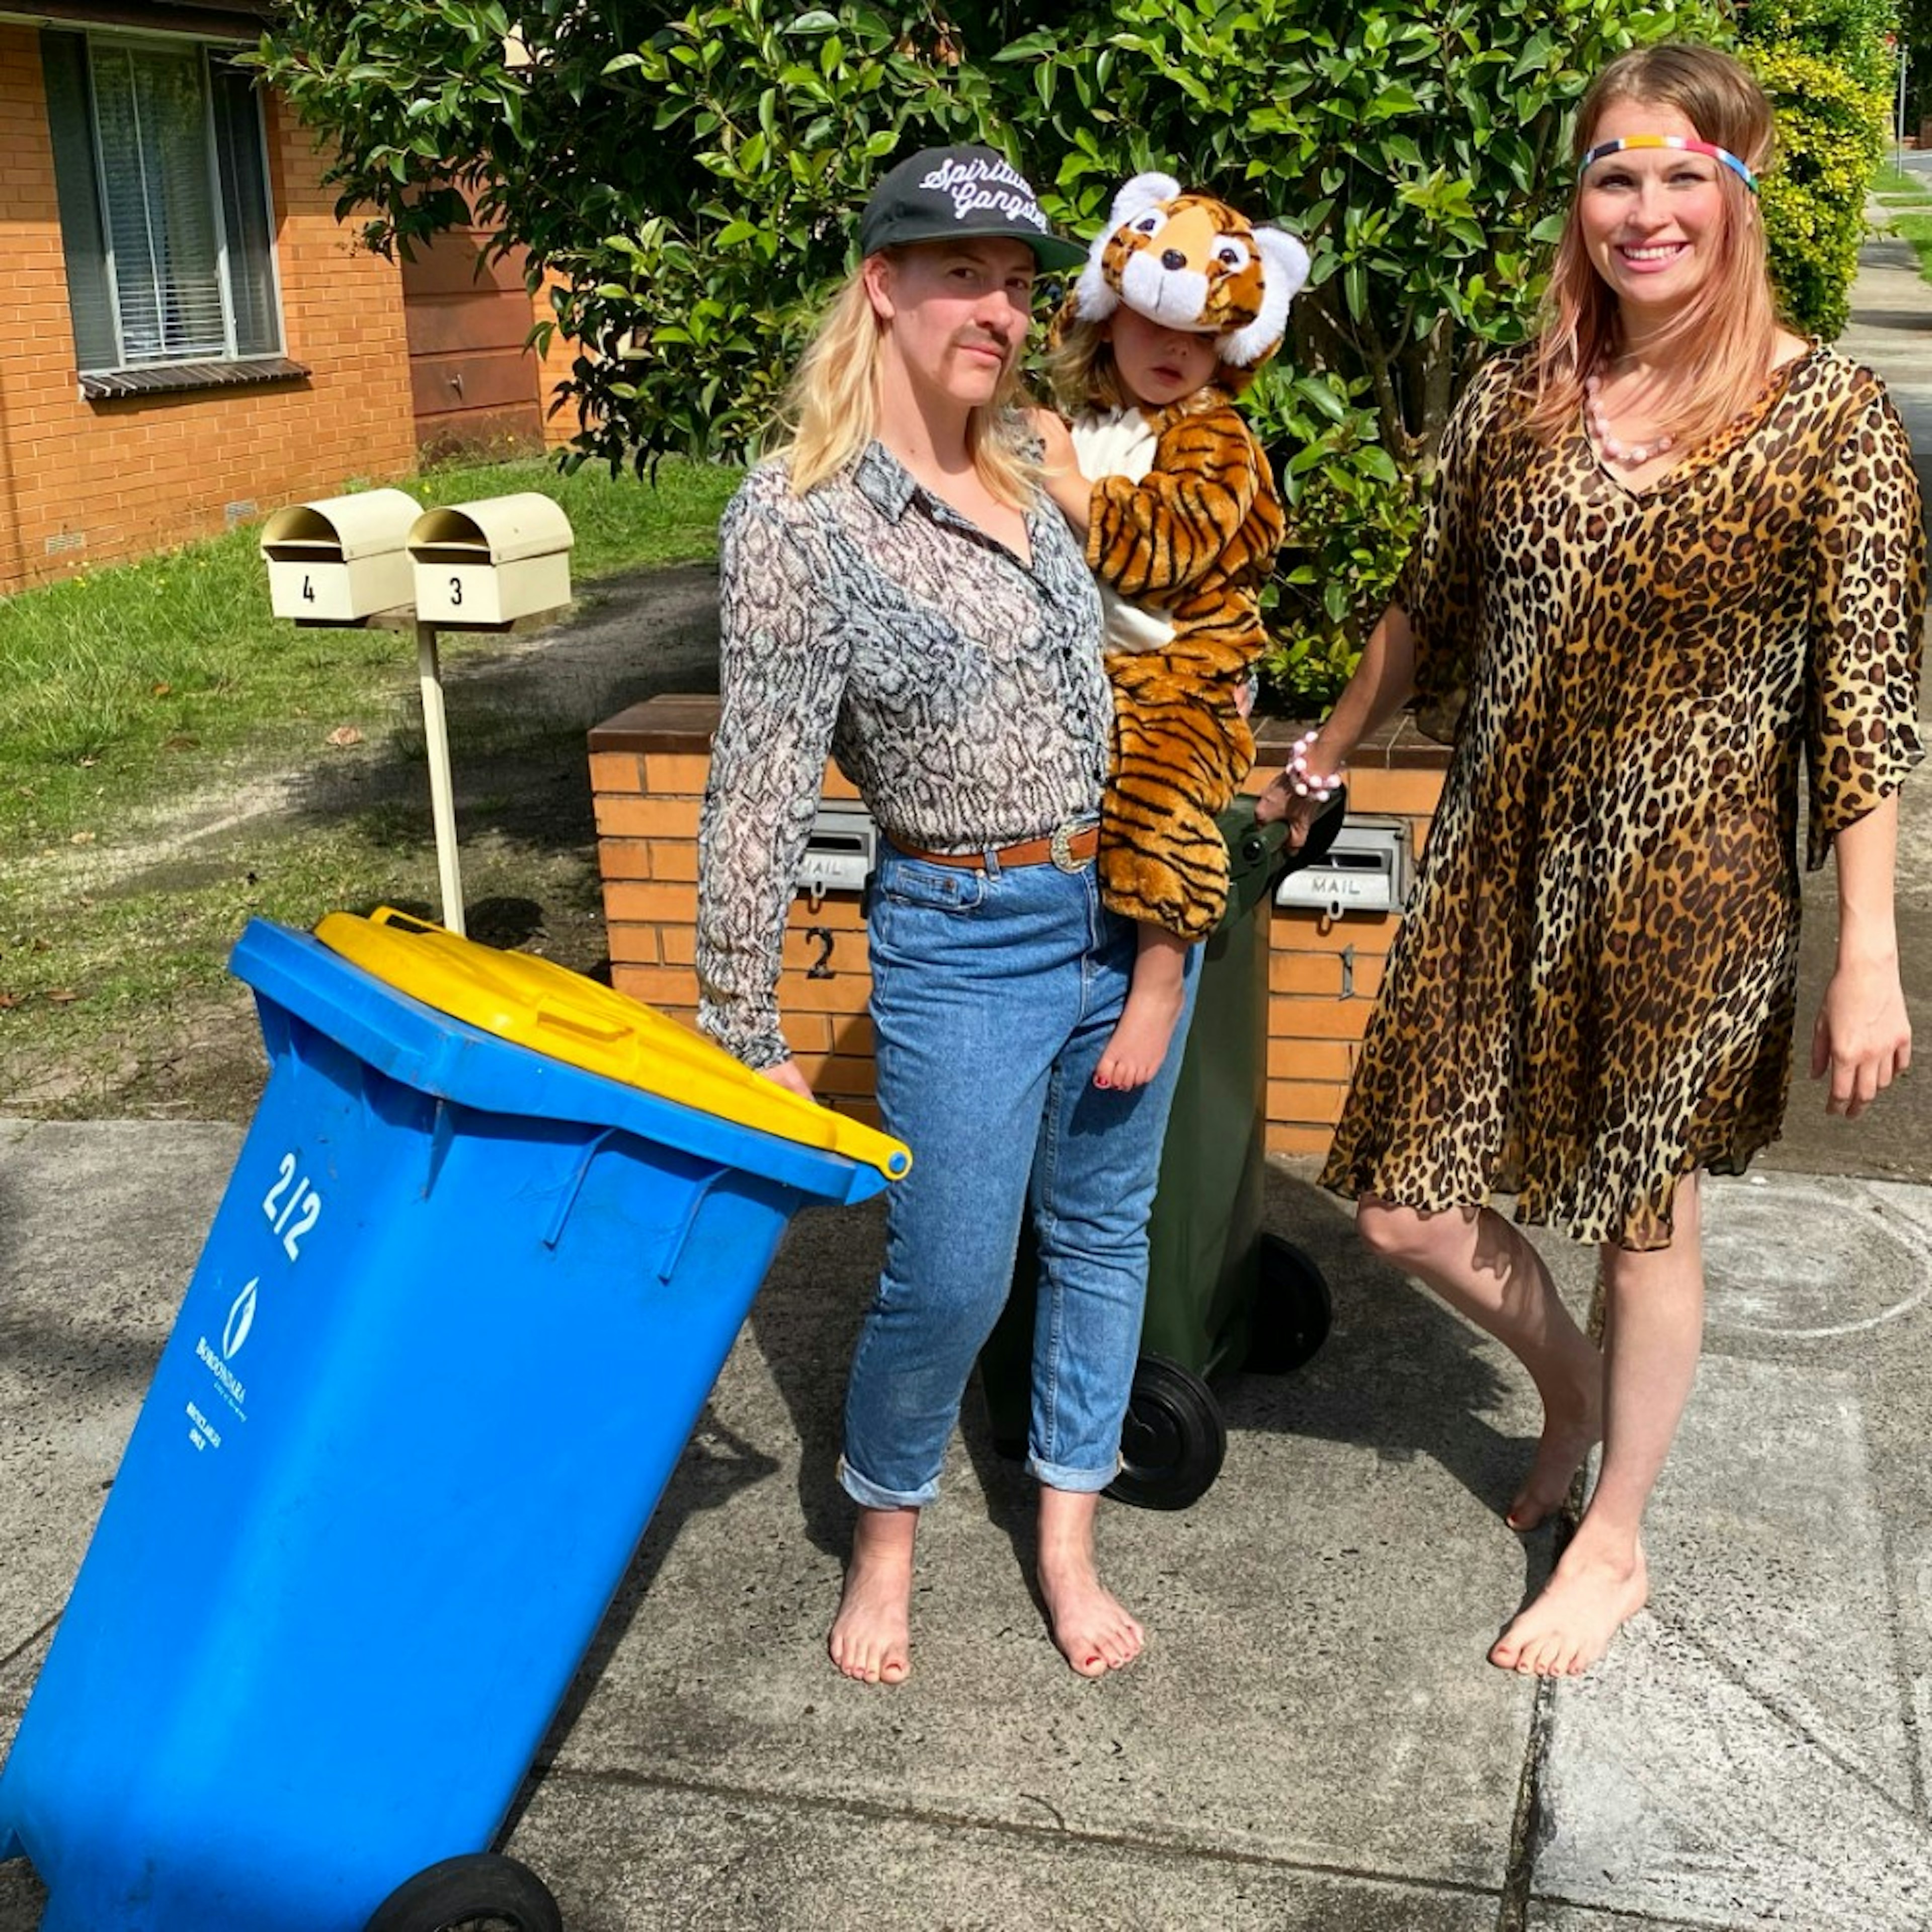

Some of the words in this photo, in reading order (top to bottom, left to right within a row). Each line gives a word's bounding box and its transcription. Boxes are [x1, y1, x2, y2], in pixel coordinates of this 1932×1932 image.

[303, 575, 314, 603] 4
[450, 577, 462, 605] 3
[807, 859, 841, 876] AIL
[1312, 878, 1360, 895] MAIL
[806, 927, 837, 979] 2
[1338, 943, 1354, 1001] 1
[262, 1152, 321, 1262] 2/2
